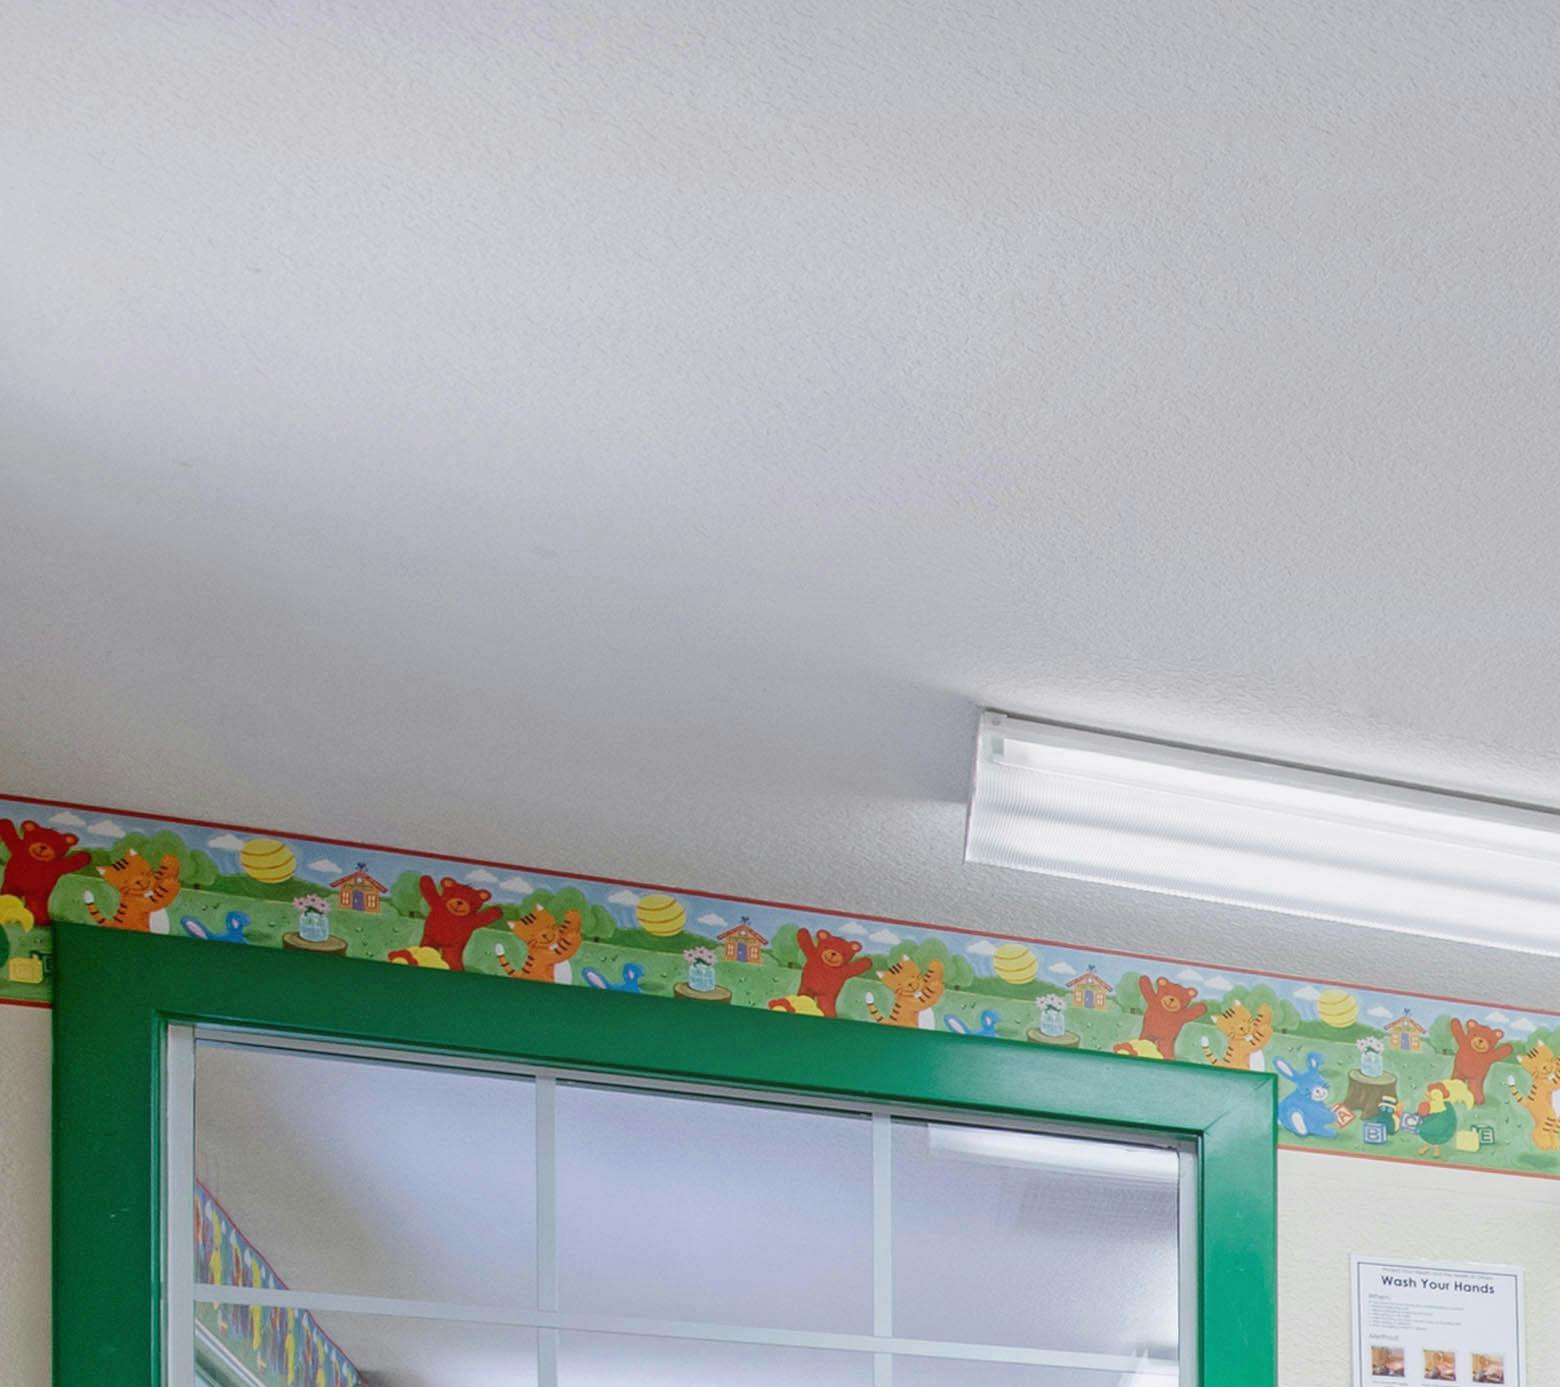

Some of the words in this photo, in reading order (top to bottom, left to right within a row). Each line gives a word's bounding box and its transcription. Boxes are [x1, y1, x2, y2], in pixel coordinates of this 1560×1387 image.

[1381, 1275, 1417, 1289] Wash
[1420, 1279, 1450, 1292] Your
[1454, 1283, 1495, 1295] Hands
